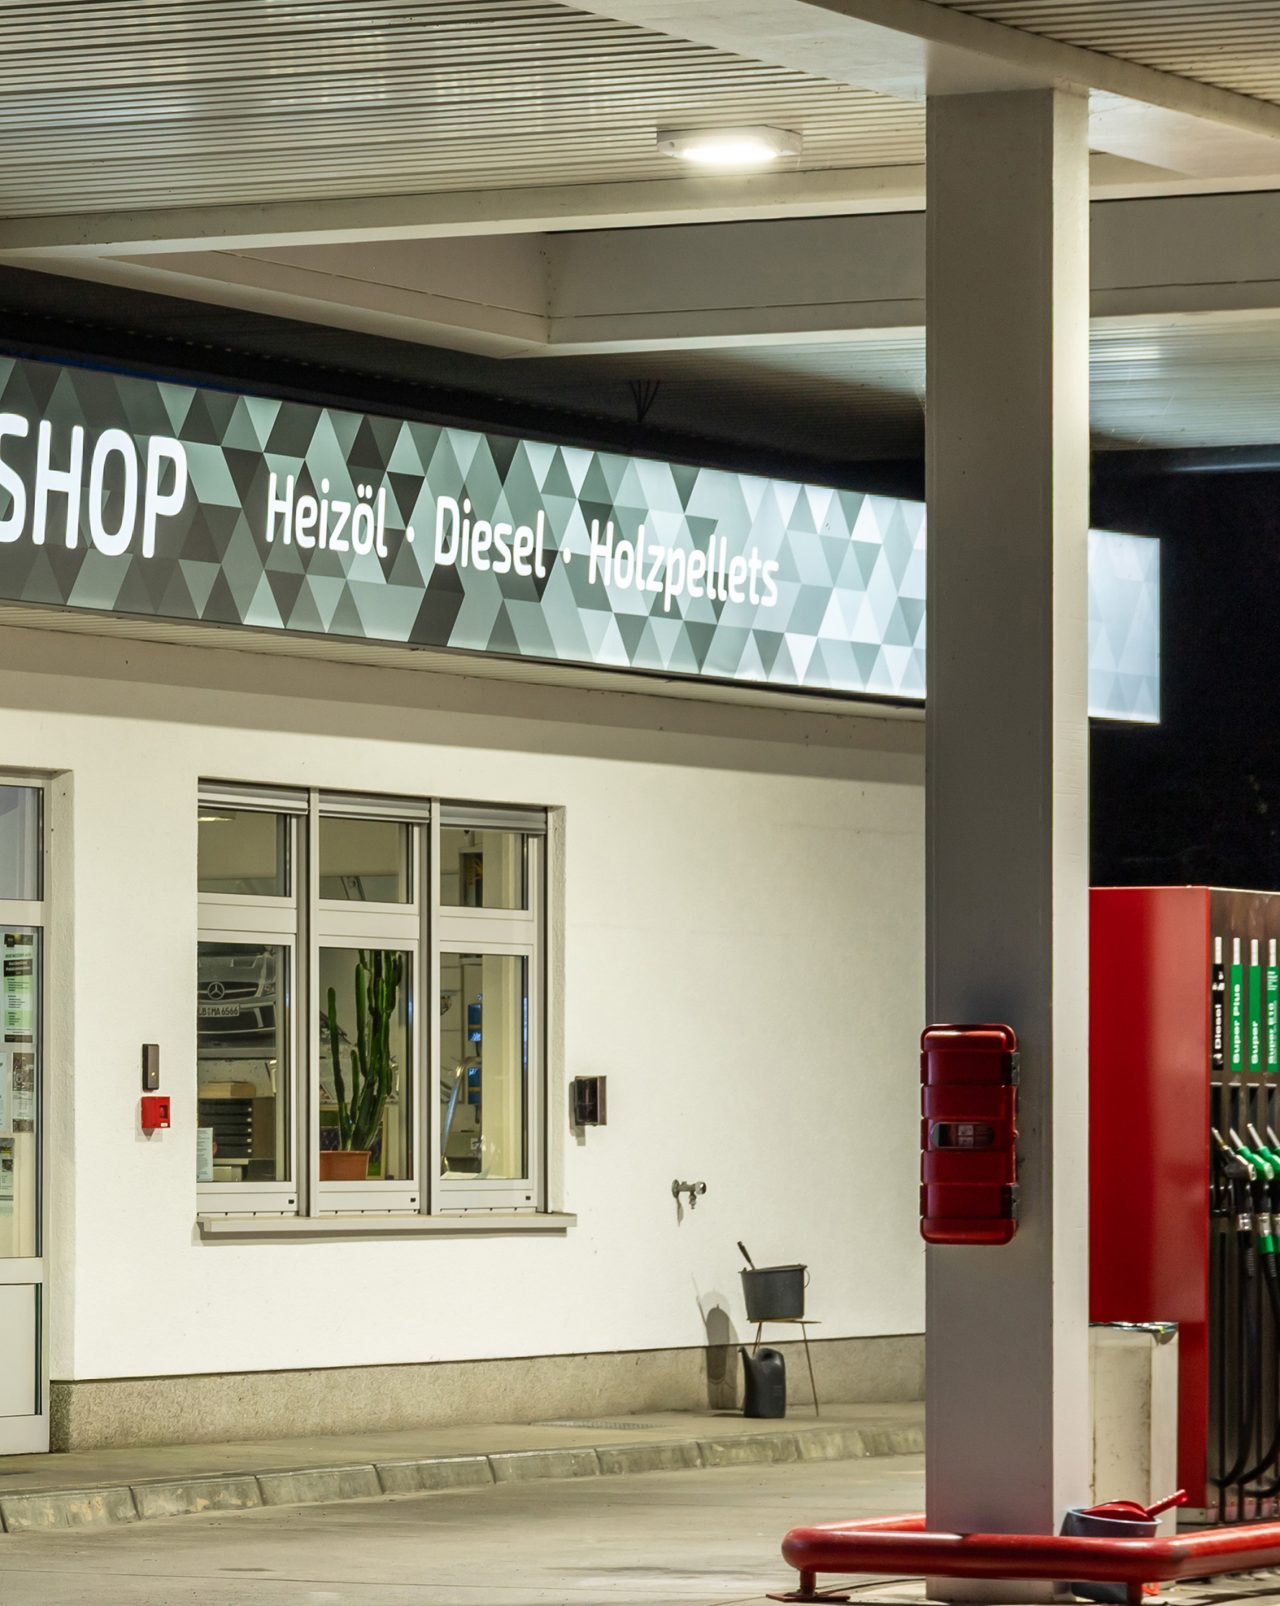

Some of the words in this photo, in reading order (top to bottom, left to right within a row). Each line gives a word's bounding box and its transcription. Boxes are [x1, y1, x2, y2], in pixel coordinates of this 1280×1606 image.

[265, 472, 388, 558] Heizöl
[434, 495, 546, 579] Diesel
[588, 518, 780, 613] Holzpellets
[1214, 1004, 1222, 1050] Diesel
[1233, 1020, 1241, 1064] Super
[1251, 1021, 1259, 1064] Super
